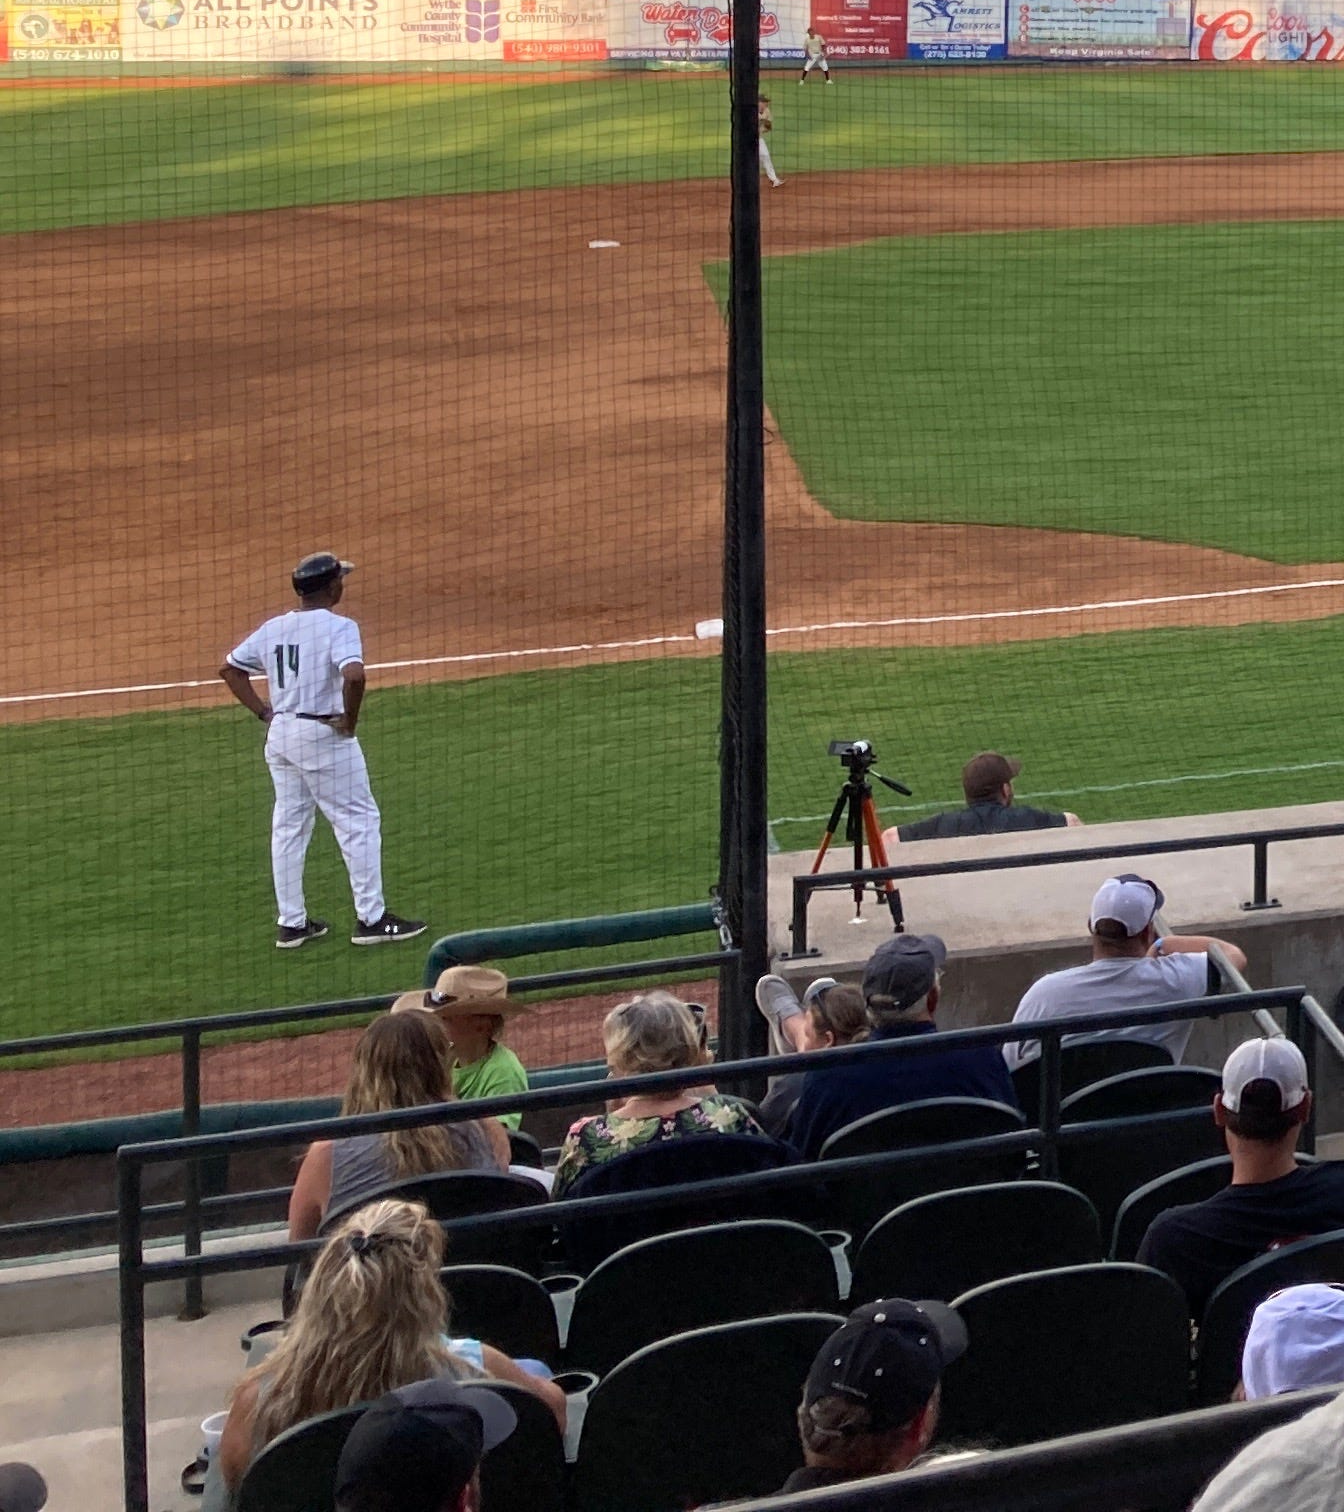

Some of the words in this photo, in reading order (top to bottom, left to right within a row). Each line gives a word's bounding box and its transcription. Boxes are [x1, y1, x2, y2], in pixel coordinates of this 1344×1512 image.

[538, 4, 559, 13] First
[424, 11, 461, 22] County
[506, 12, 578, 25] Community
[581, 13, 604, 23] Bank
[194, 15, 378, 30] BROADBAND
[400, 22, 461, 33] Community
[418, 33, 462, 44] Hospital
[512, 42, 543, 54] (540)
[1050, 48, 1079, 56] Keep
[1081, 47, 1124, 57] Virginia
[12, 49, 49, 61] (540)
[53, 49, 120, 60] 674-1010
[273, 644, 299, 689] 14
